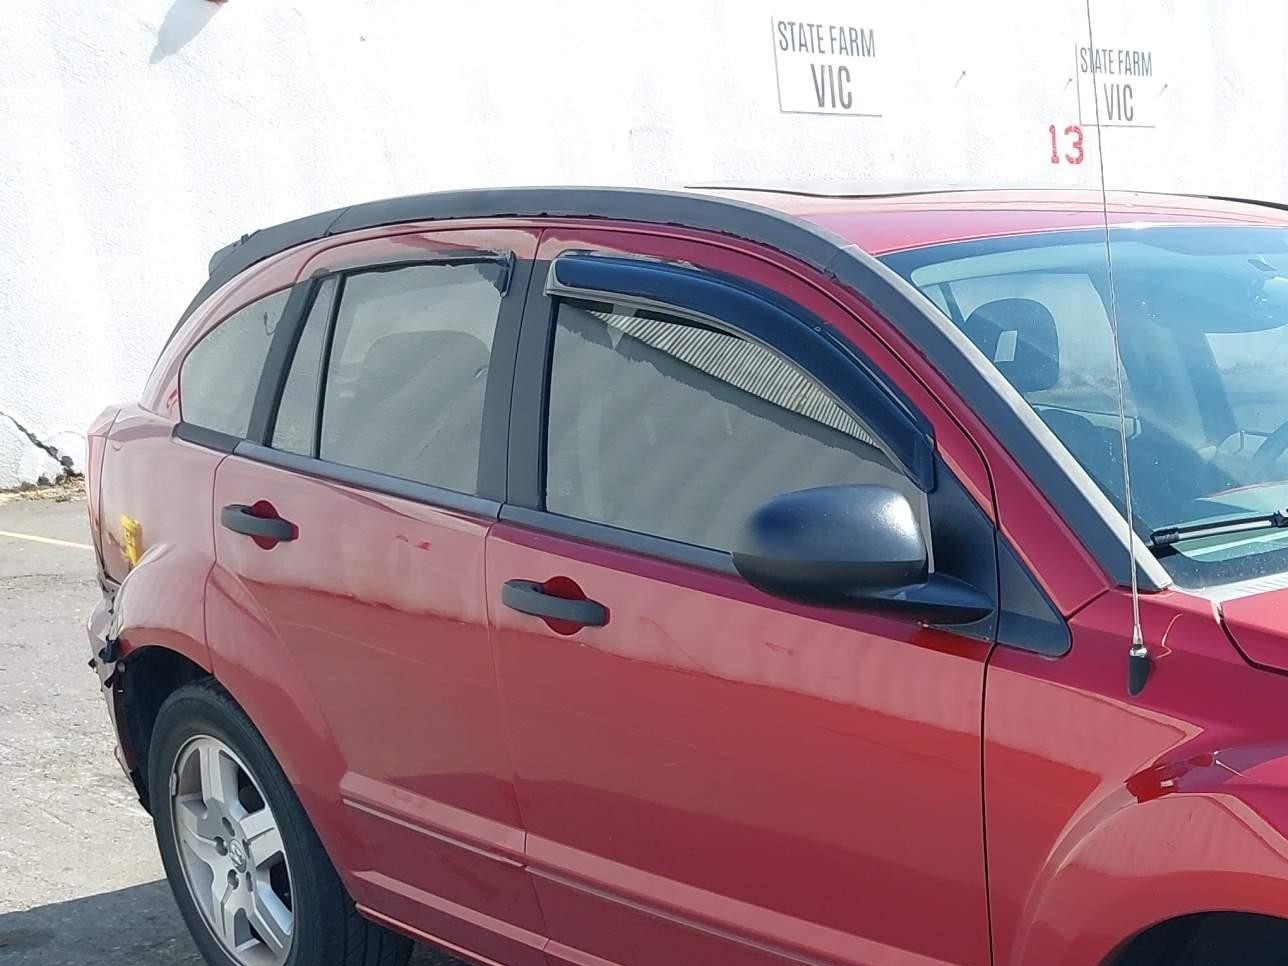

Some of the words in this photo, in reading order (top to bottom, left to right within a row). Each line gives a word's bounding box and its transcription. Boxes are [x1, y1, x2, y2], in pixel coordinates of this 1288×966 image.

[778, 20, 825, 54] STATE
[829, 25, 876, 58] FARM
[1080, 47, 1115, 75] STATE
[1118, 49, 1152, 77] FARM
[810, 63, 852, 109] VIC
[1103, 83, 1133, 121] VIC
[1049, 124, 1084, 164] 13
